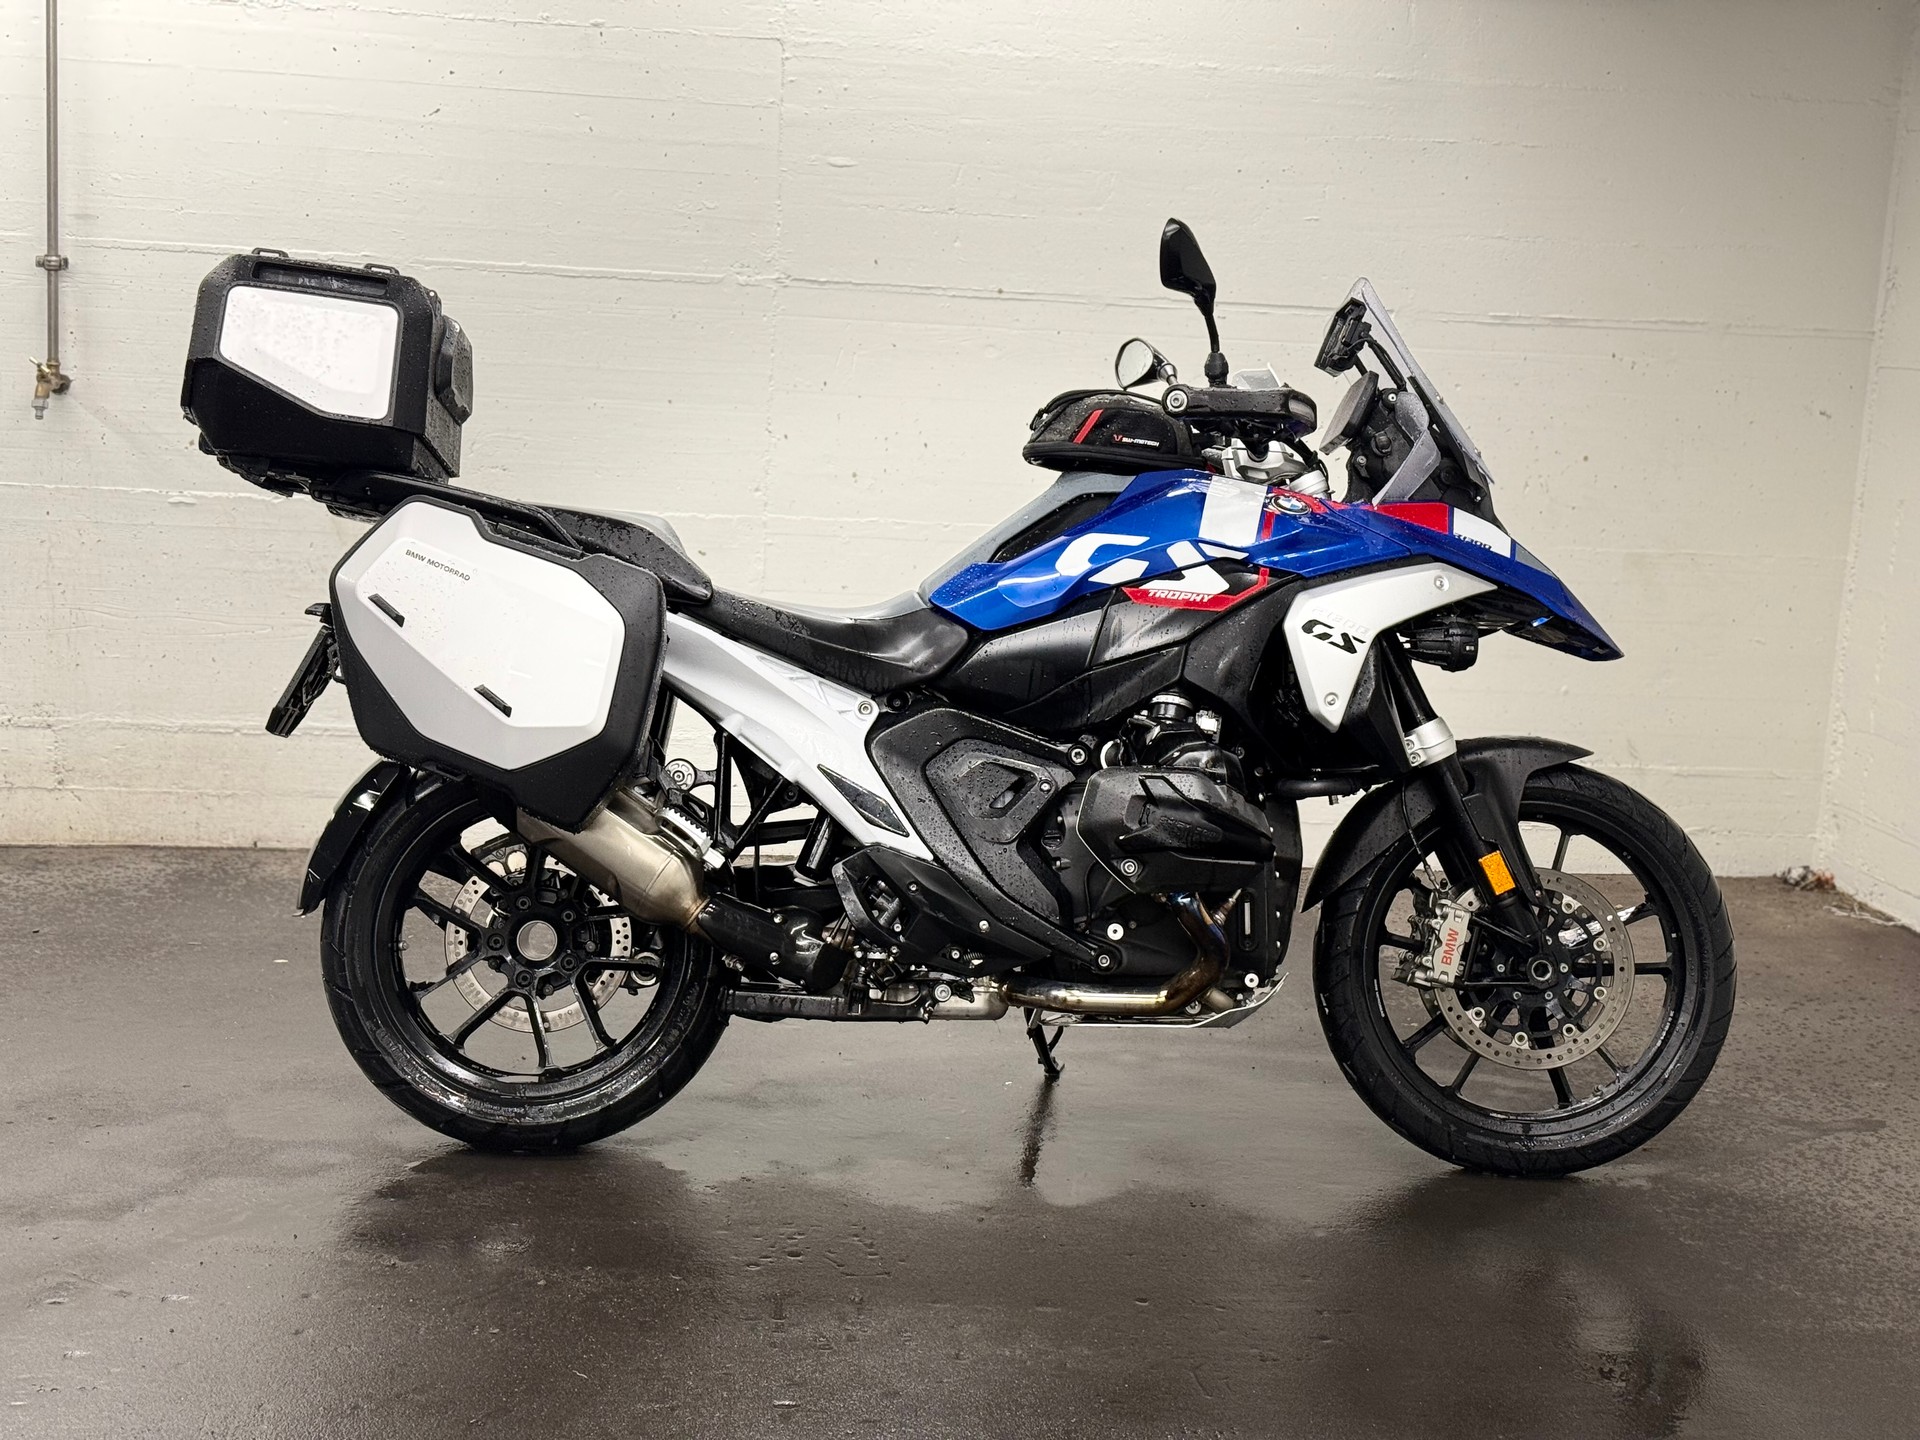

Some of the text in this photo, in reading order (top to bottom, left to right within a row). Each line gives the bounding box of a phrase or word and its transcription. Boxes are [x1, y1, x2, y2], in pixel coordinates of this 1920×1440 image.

[405, 549, 471, 581] BMW MOTORRAD
[1148, 589, 1214, 603] TROPHY
[1301, 618, 1367, 655] GS
[1441, 927, 1459, 966] BMW
